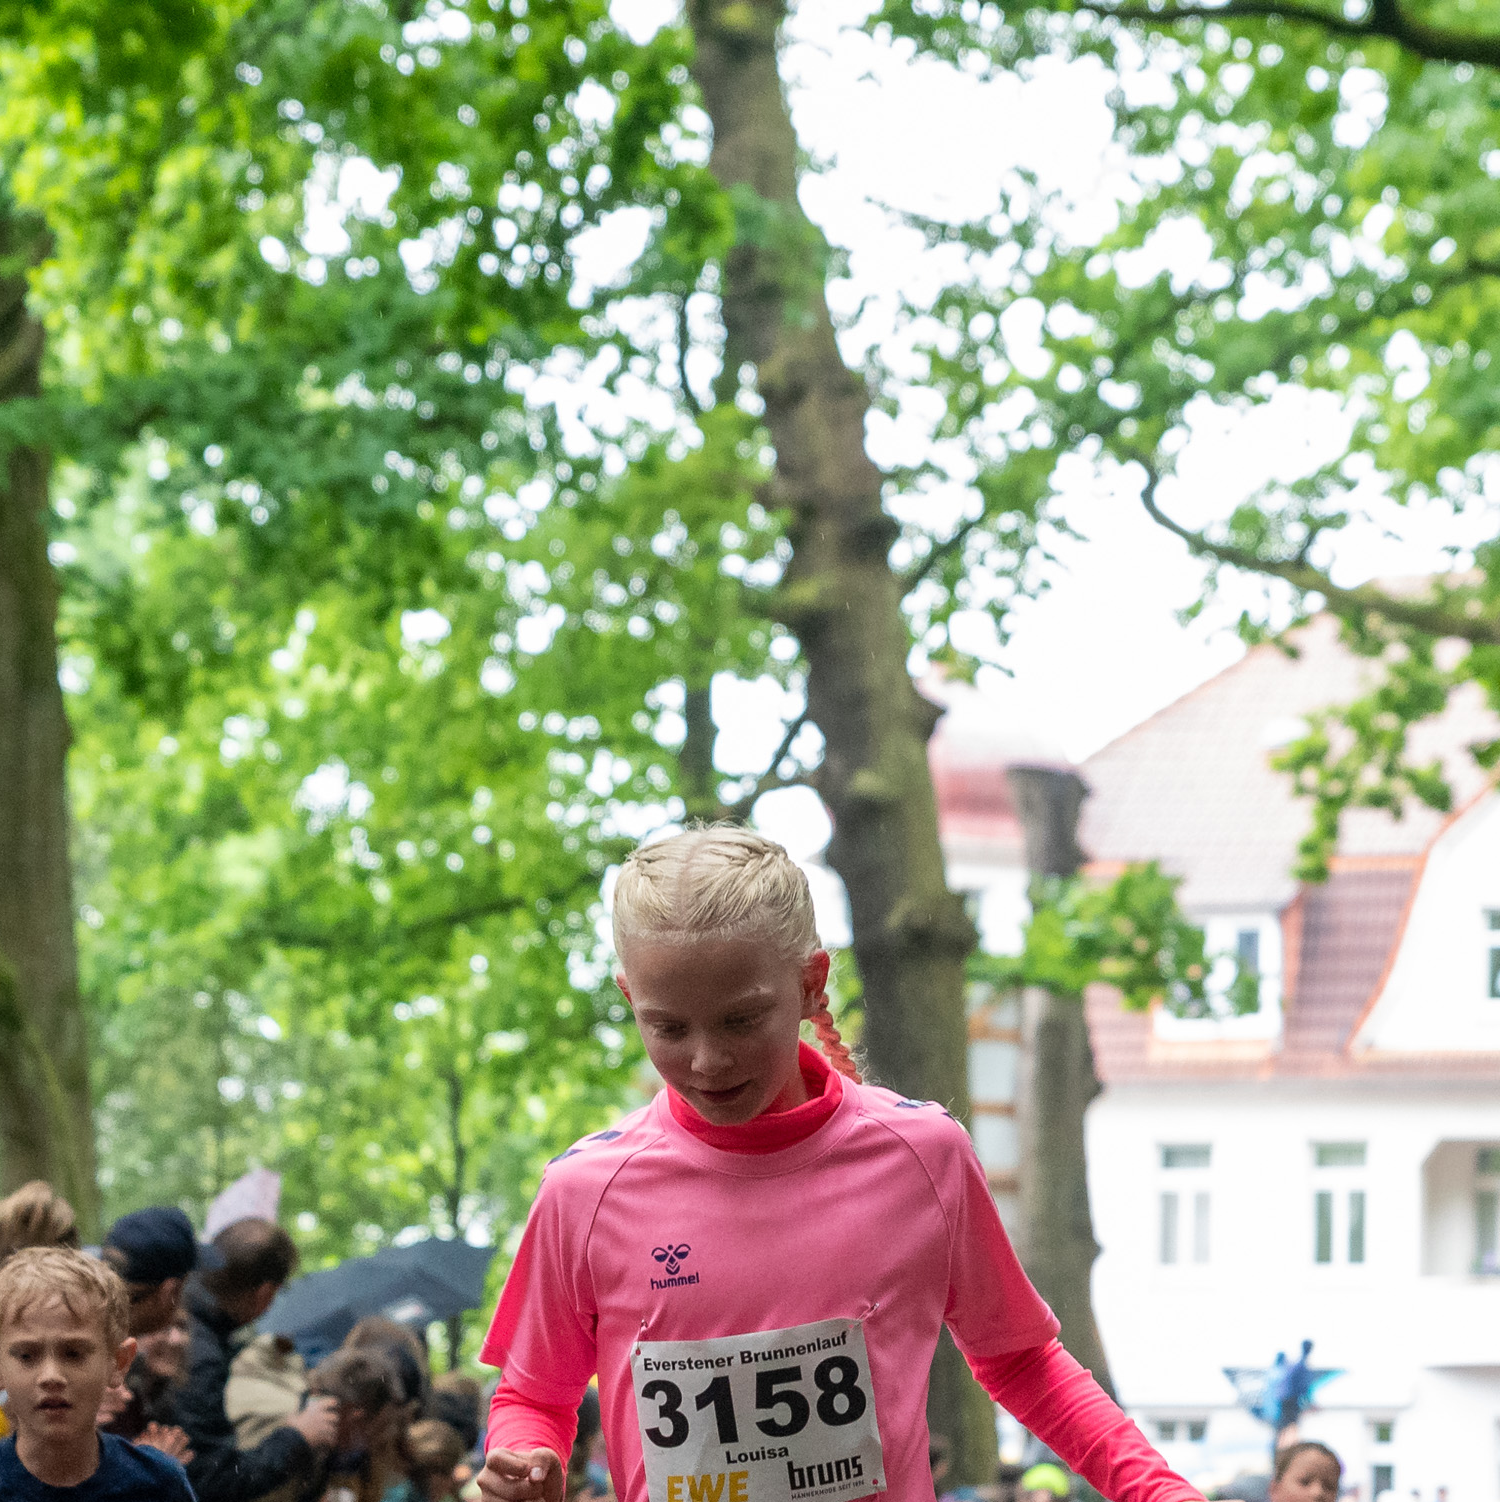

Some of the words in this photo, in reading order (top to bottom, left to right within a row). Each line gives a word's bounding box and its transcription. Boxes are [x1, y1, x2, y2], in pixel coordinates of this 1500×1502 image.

[650, 1272, 700, 1290] hummel
[643, 1354, 735, 1372] Everstener
[740, 1331, 848, 1365] Brunnenlauf
[641, 1355, 868, 1449] 3158
[725, 1445, 790, 1465] Louisa
[786, 1455, 864, 1491] bruns
